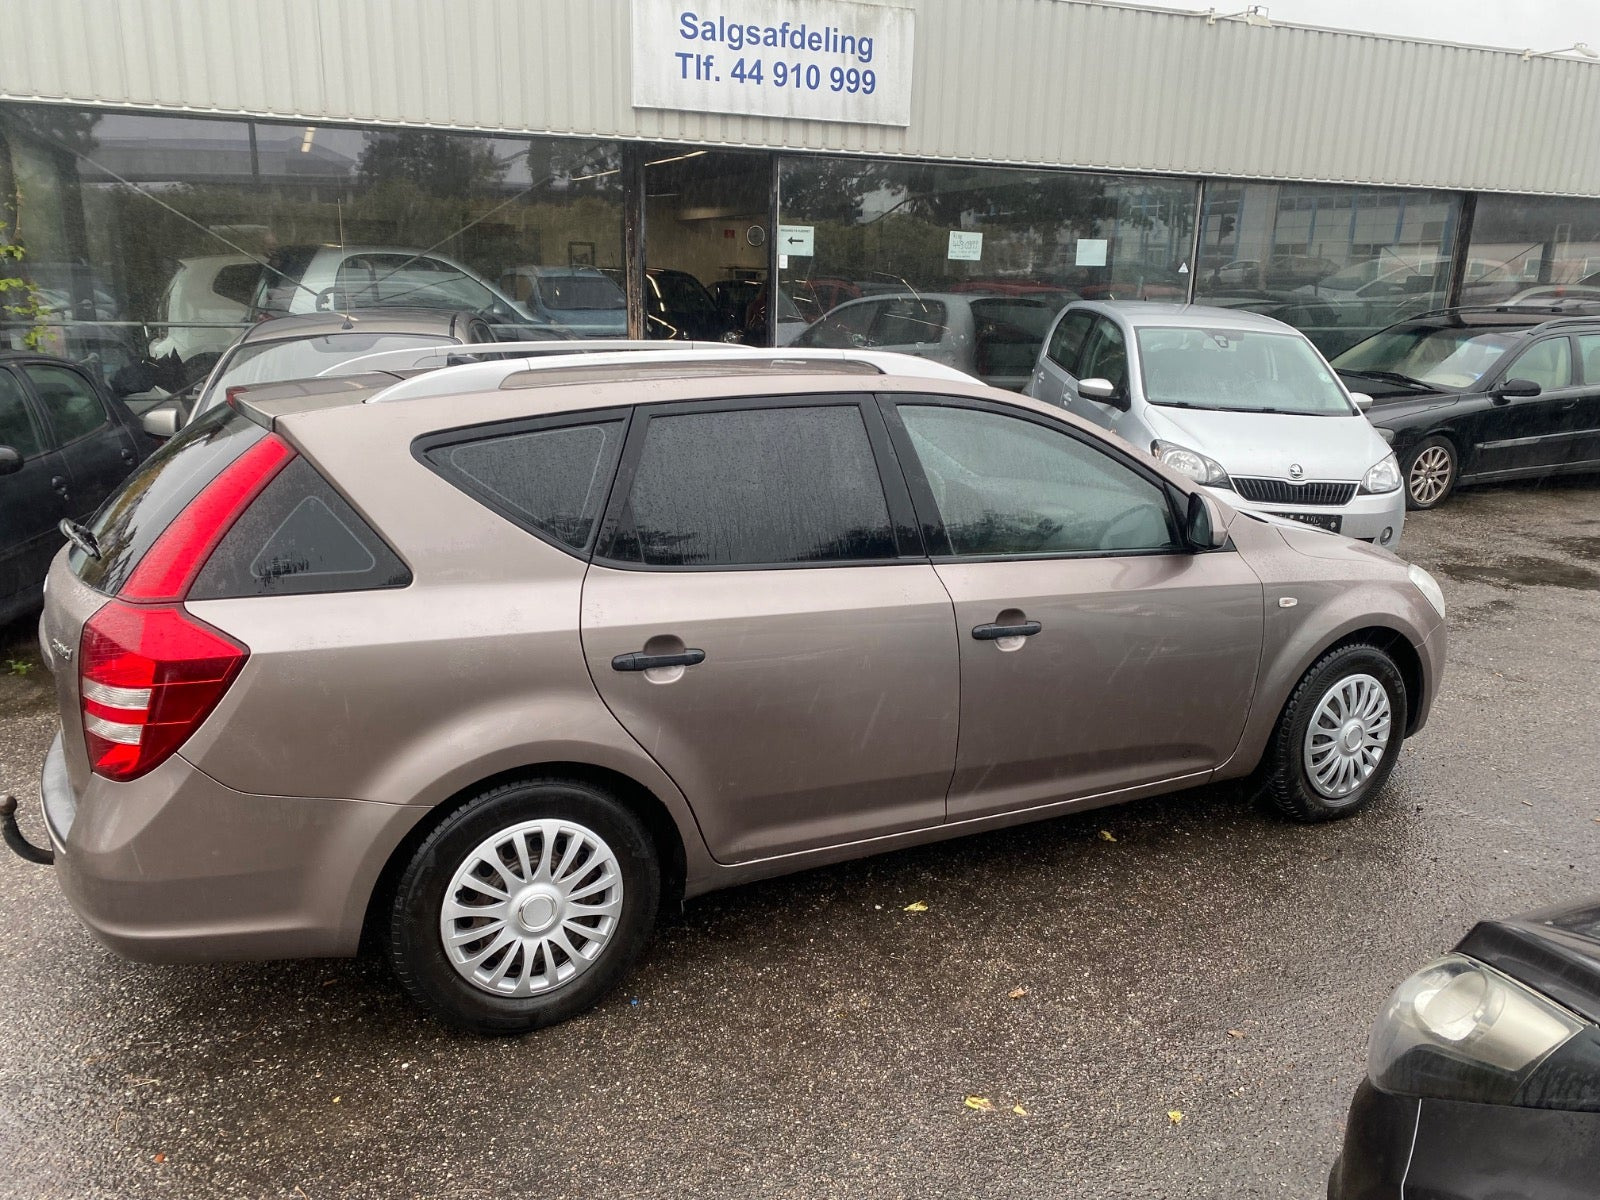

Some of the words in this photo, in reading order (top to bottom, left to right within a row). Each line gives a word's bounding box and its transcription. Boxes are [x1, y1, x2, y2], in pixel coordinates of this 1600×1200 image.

[679, 11, 874, 63] Salgsafdeling
[674, 51, 721, 82] Tlf.
[730, 57, 764, 86] 44
[773, 61, 821, 91] 910
[829, 66, 877, 95] 999
